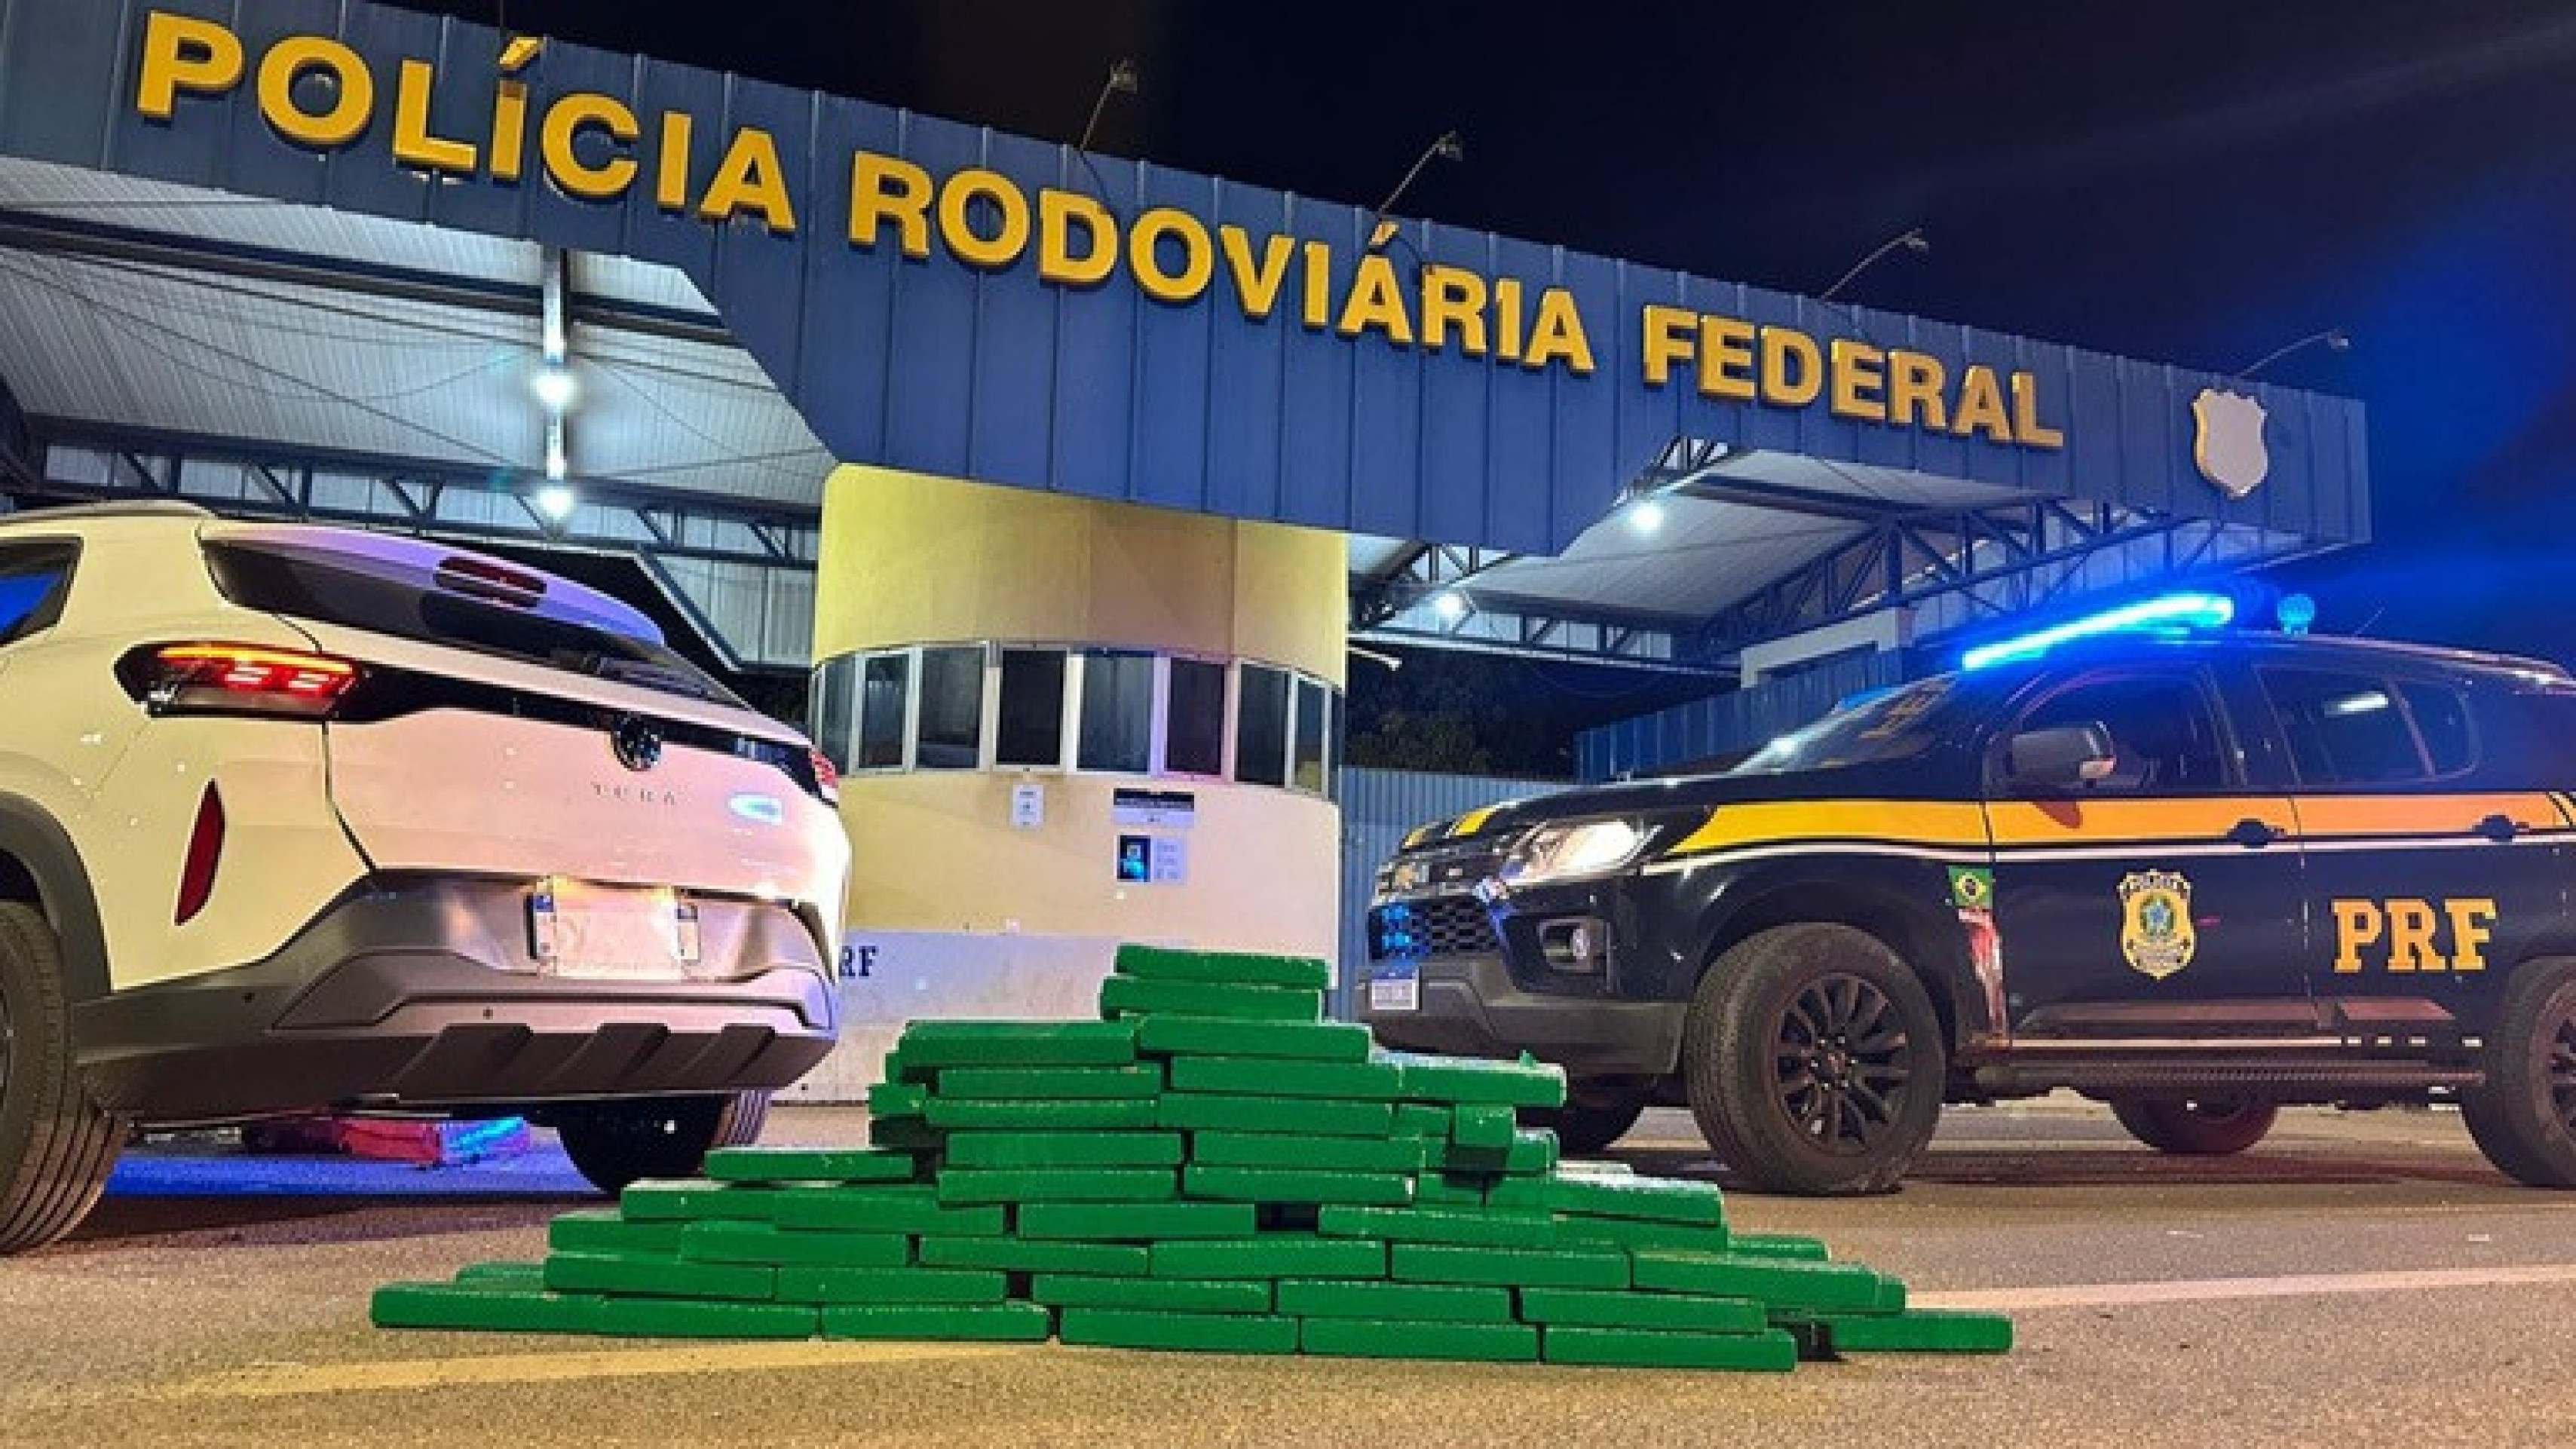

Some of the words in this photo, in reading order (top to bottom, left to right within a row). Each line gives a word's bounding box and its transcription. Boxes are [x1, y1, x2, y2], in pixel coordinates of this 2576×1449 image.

[137, 9, 796, 232] POLÍCIA
[848, 149, 1595, 373] RODOVIÁRIA
[1642, 304, 2064, 449] FEDERAL
[838, 945, 878, 979] RF
[2331, 898, 2496, 973] PRF
